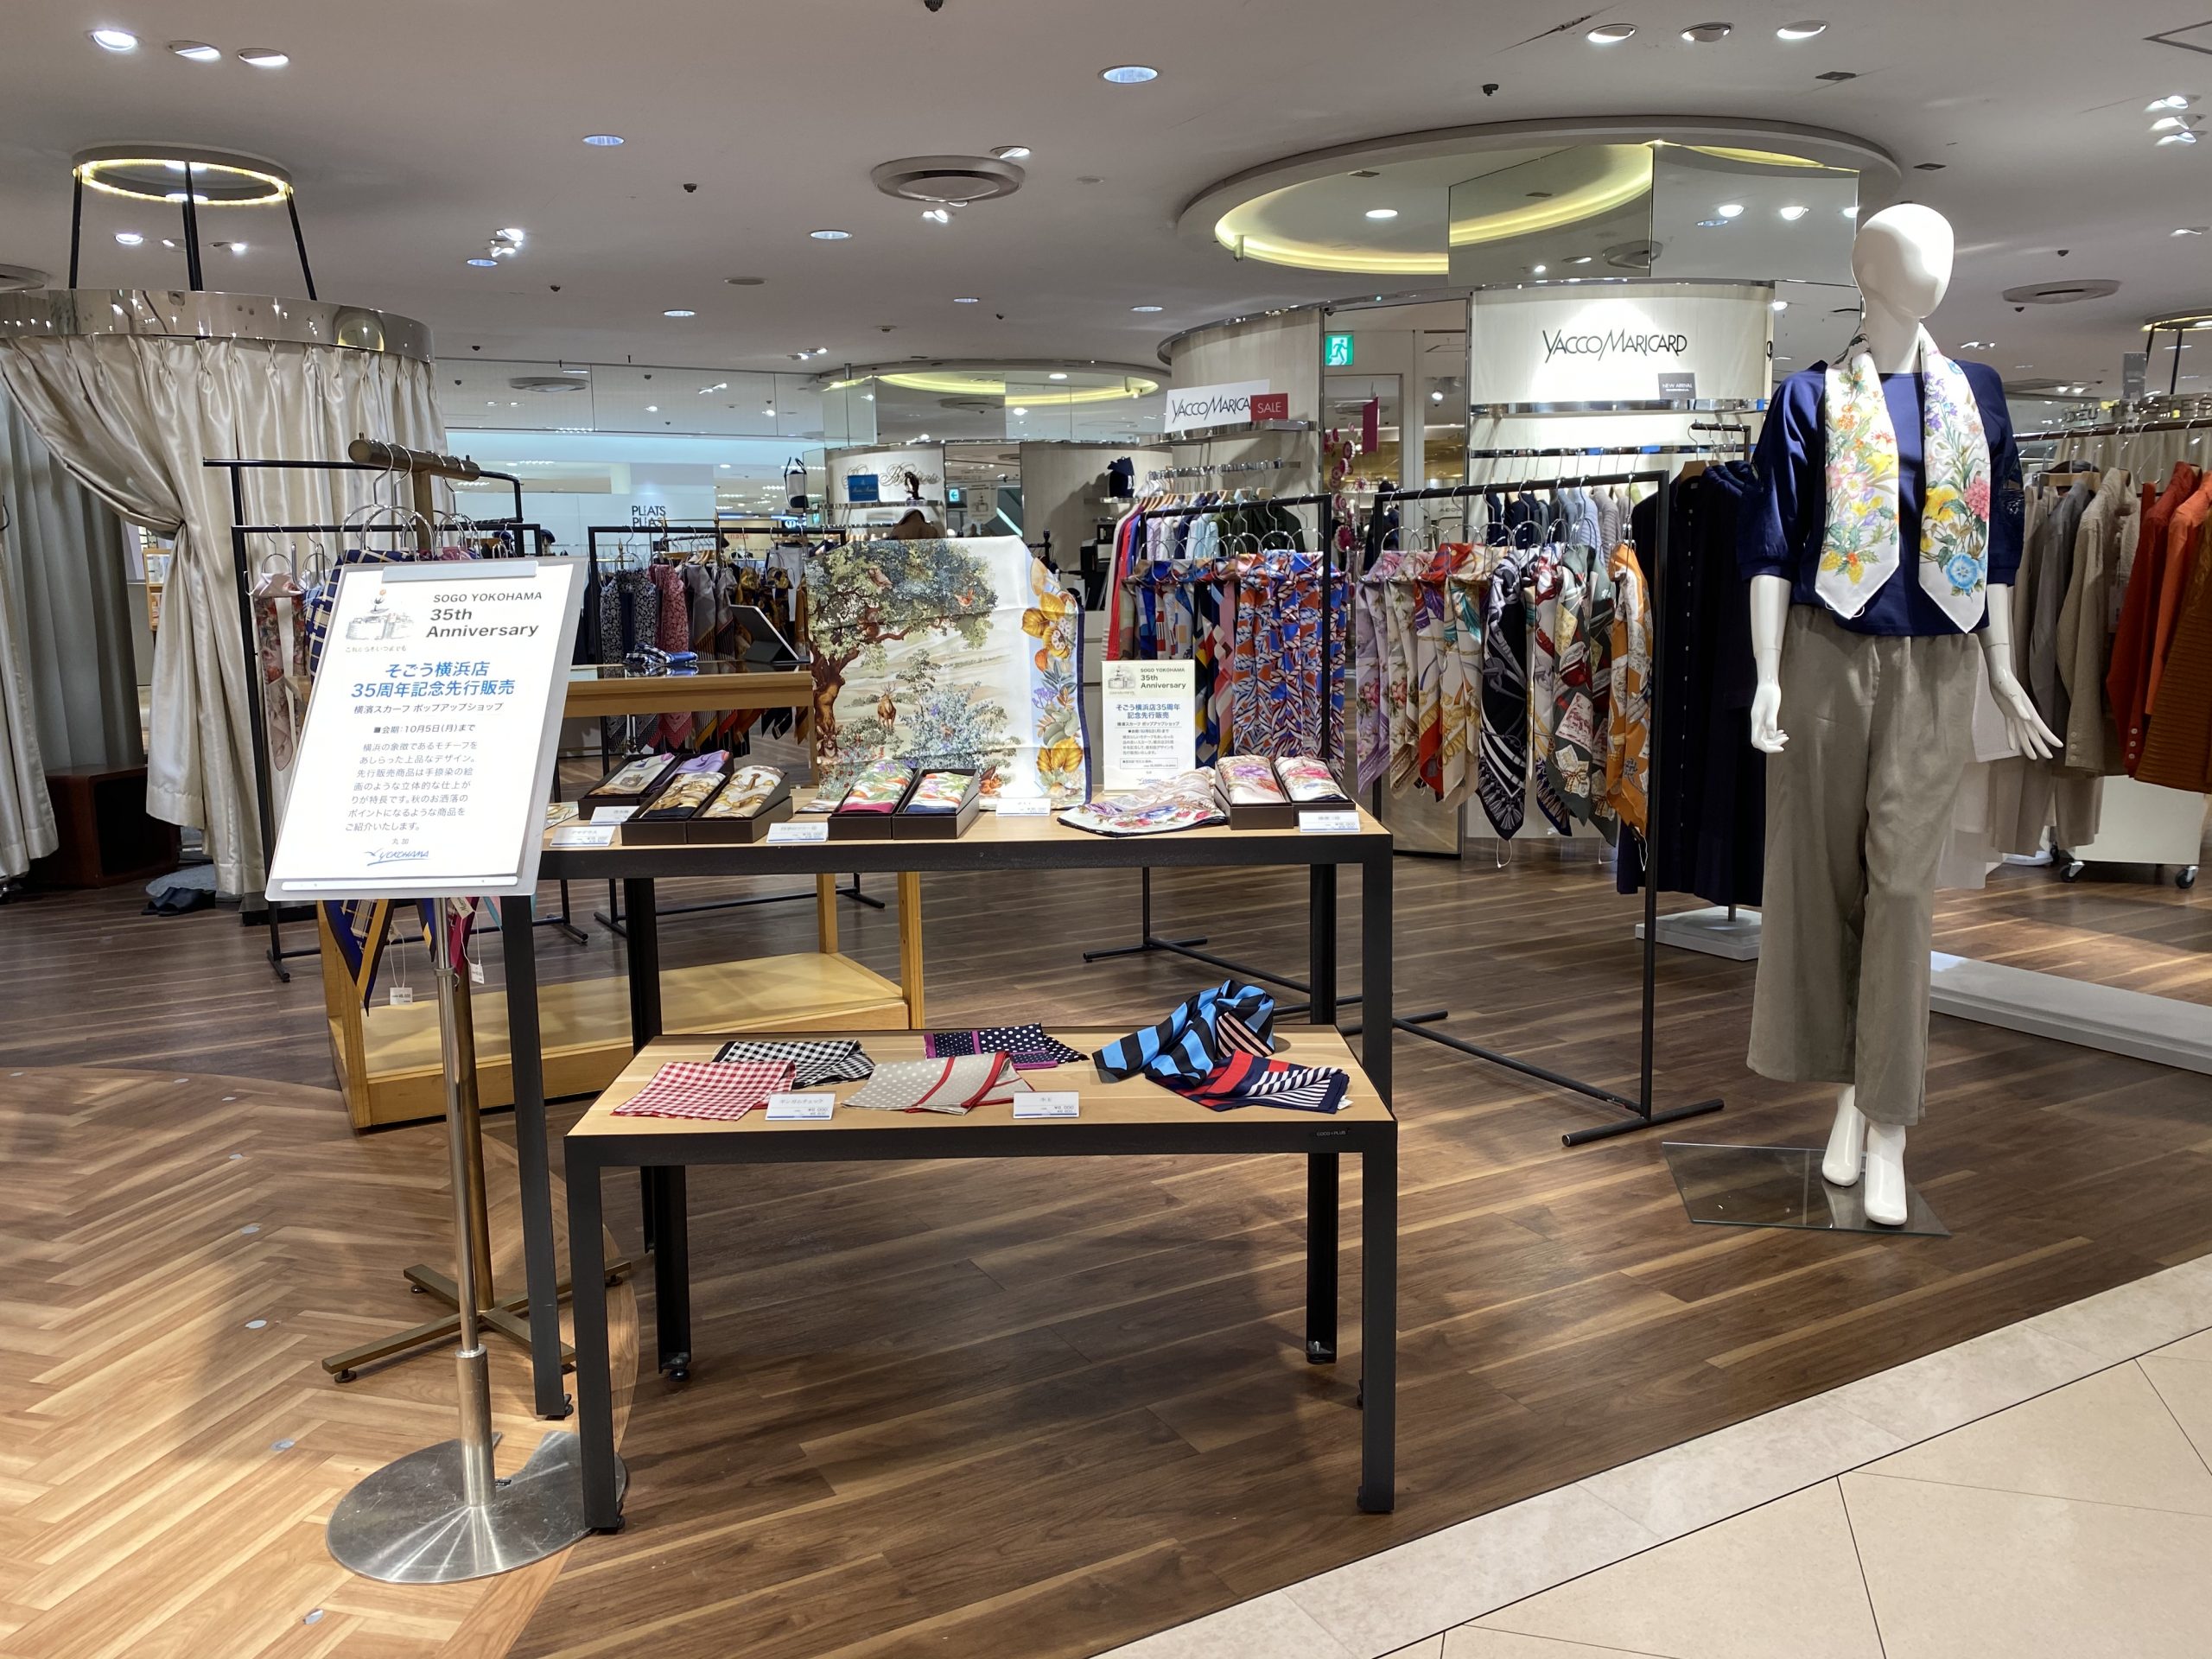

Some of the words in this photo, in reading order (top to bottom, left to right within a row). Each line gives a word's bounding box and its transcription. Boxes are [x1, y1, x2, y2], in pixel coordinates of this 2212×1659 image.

[1257, 402, 1281, 413] SALE
[632, 505, 666, 516] PLEATS
[632, 517, 664, 527] PLEAS
[433, 594, 467, 603] SOGO
[473, 591, 543, 602] YOKOHAMA
[430, 608, 473, 621] 35th
[426, 624, 539, 638] Anniversary
[385, 661, 491, 678] そごう横浜店
[351, 679, 515, 698] 35周年記念先行販売
[353, 704, 410, 715] 横濱スカーフ
[413, 702, 504, 714] ポップアップショップ
[363, 741, 478, 752] 横浜の象徴であるモチーフを
[359, 754, 475, 765] あしらった上品なデザイン。
[353, 781, 471, 791] 画のような立体的な仕上が
[347, 807, 466, 817] ポイントになるような商品を
[345, 822, 421, 832] ご紹介いたします。
